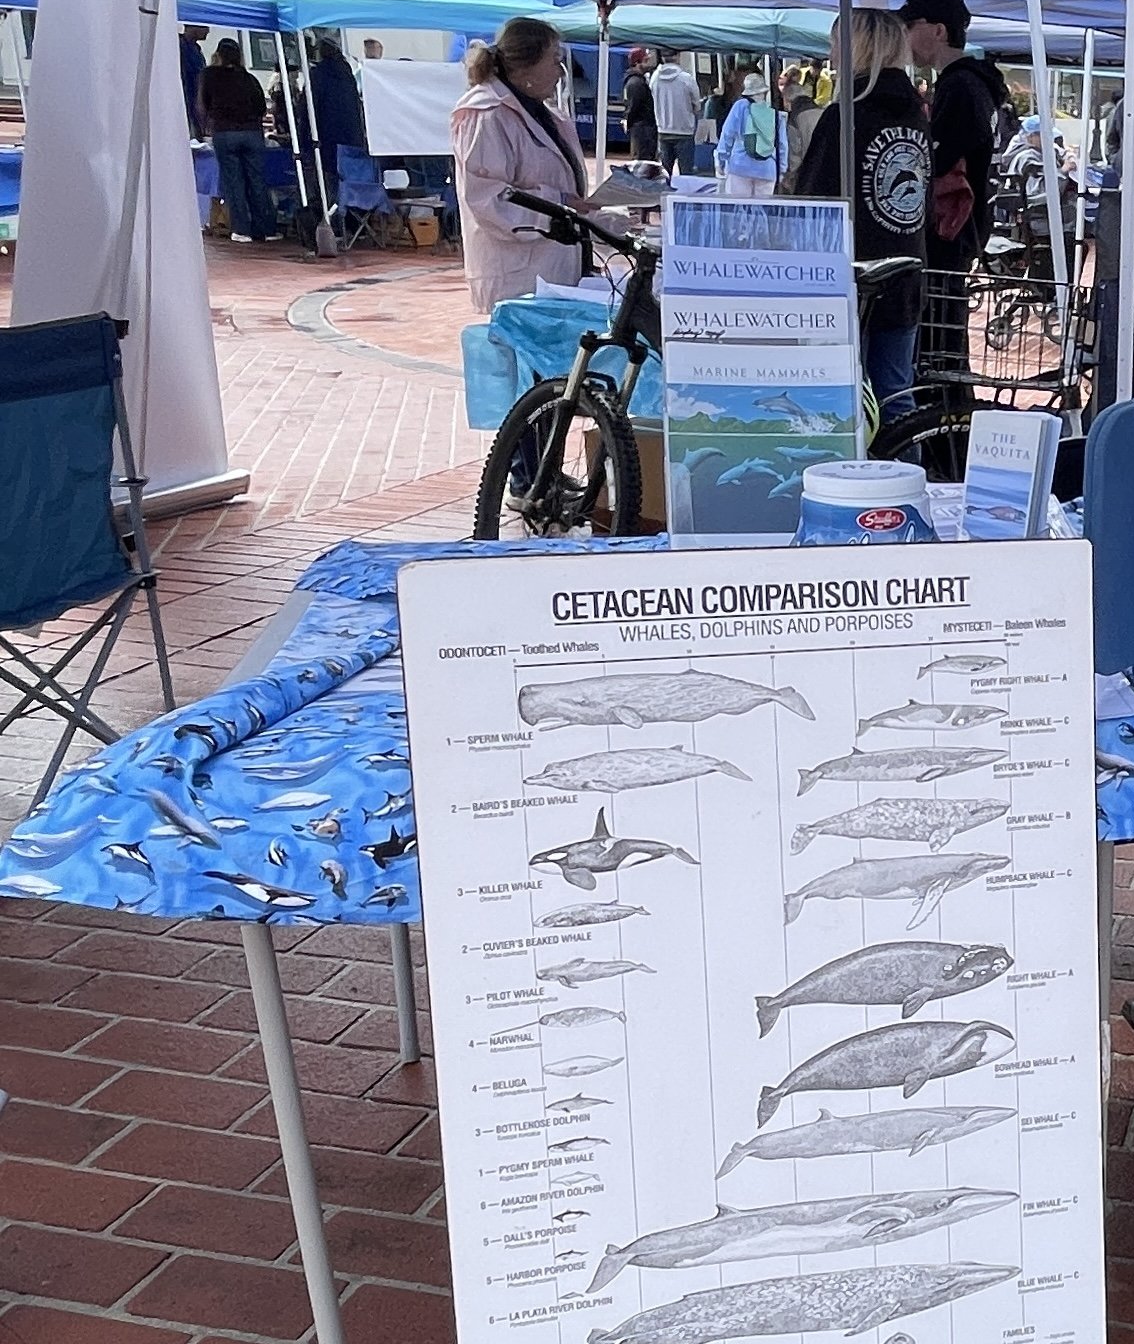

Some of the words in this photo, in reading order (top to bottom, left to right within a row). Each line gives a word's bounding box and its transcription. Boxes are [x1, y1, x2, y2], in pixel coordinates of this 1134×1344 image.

[673, 259, 837, 282] WHALEWATCHER
[673, 311, 837, 329] WHALEWATCHER
[693, 366, 747, 378] MARINE
[757, 367, 827, 379] MAMMALS
[992, 432, 1017, 445] THE
[975, 443, 1031, 461] VAQUITA
[552, 587, 695, 622] CETACEAN
[701, 578, 879, 615] COMPARISON
[886, 575, 971, 605] CHART
[618, 623, 697, 642] WHALES,
[700, 617, 784, 640] DOLPHINS
[787, 617, 821, 635] AND
[825, 612, 914, 633] PORPOISES
[521, 642, 561, 655] Toothed
[562, 640, 600, 653] Whales
[1024, 673, 1050, 684] WHALE
[1025, 717, 1052, 728] WHALE
[467, 733, 500, 746] SPERM
[501, 731, 535, 743] WHALE
[1027, 760, 1053, 771] WHALE
[472, 799, 510, 813] BAIRD'S
[511, 796, 546, 810] BEAKED
[546, 794, 579, 806] WHALE
[1027, 812, 1054, 824] WHALE
[1028, 870, 1055, 882] WHALE
[478, 882, 511, 896] KILLER
[511, 879, 543, 892] WHALE
[482, 938, 524, 953] CUVIER'S
[525, 934, 560, 949] BEAKED
[561, 931, 593, 944] WHALE
[1030, 969, 1057, 981] WHALE
[486, 990, 512, 1002] PILOT
[513, 987, 545, 1000] WHALE
[489, 1032, 535, 1047] NARWHAL
[1032, 1056, 1059, 1069] WHALE
[492, 1078, 528, 1091] BELUGA
[495, 1117, 552, 1135] BOTTLENOSE
[552, 1113, 591, 1128] DOLPHIN
[1033, 1112, 1060, 1125] WHALE
[498, 1162, 531, 1176] PYGMY
[531, 1157, 563, 1171] SPERM
[564, 1152, 596, 1165] WHALE
[500, 1194, 538, 1208] AMAZON
[539, 1188, 566, 1202] RIVER
[566, 1183, 605, 1198] DOLPHIN
[1035, 1197, 1062, 1210] WHALE
[503, 1230, 534, 1244] DALL'S
[534, 1224, 577, 1239] PORPOISE
[506, 1267, 543, 1283] HARBOR
[544, 1261, 587, 1276] PORPOISE
[1037, 1273, 1063, 1287] WHALE
[509, 1310, 521, 1323] LA
[521, 1306, 549, 1321] PLATA
[549, 1300, 575, 1314] RIVER
[575, 1296, 613, 1311] DOLPHIN
